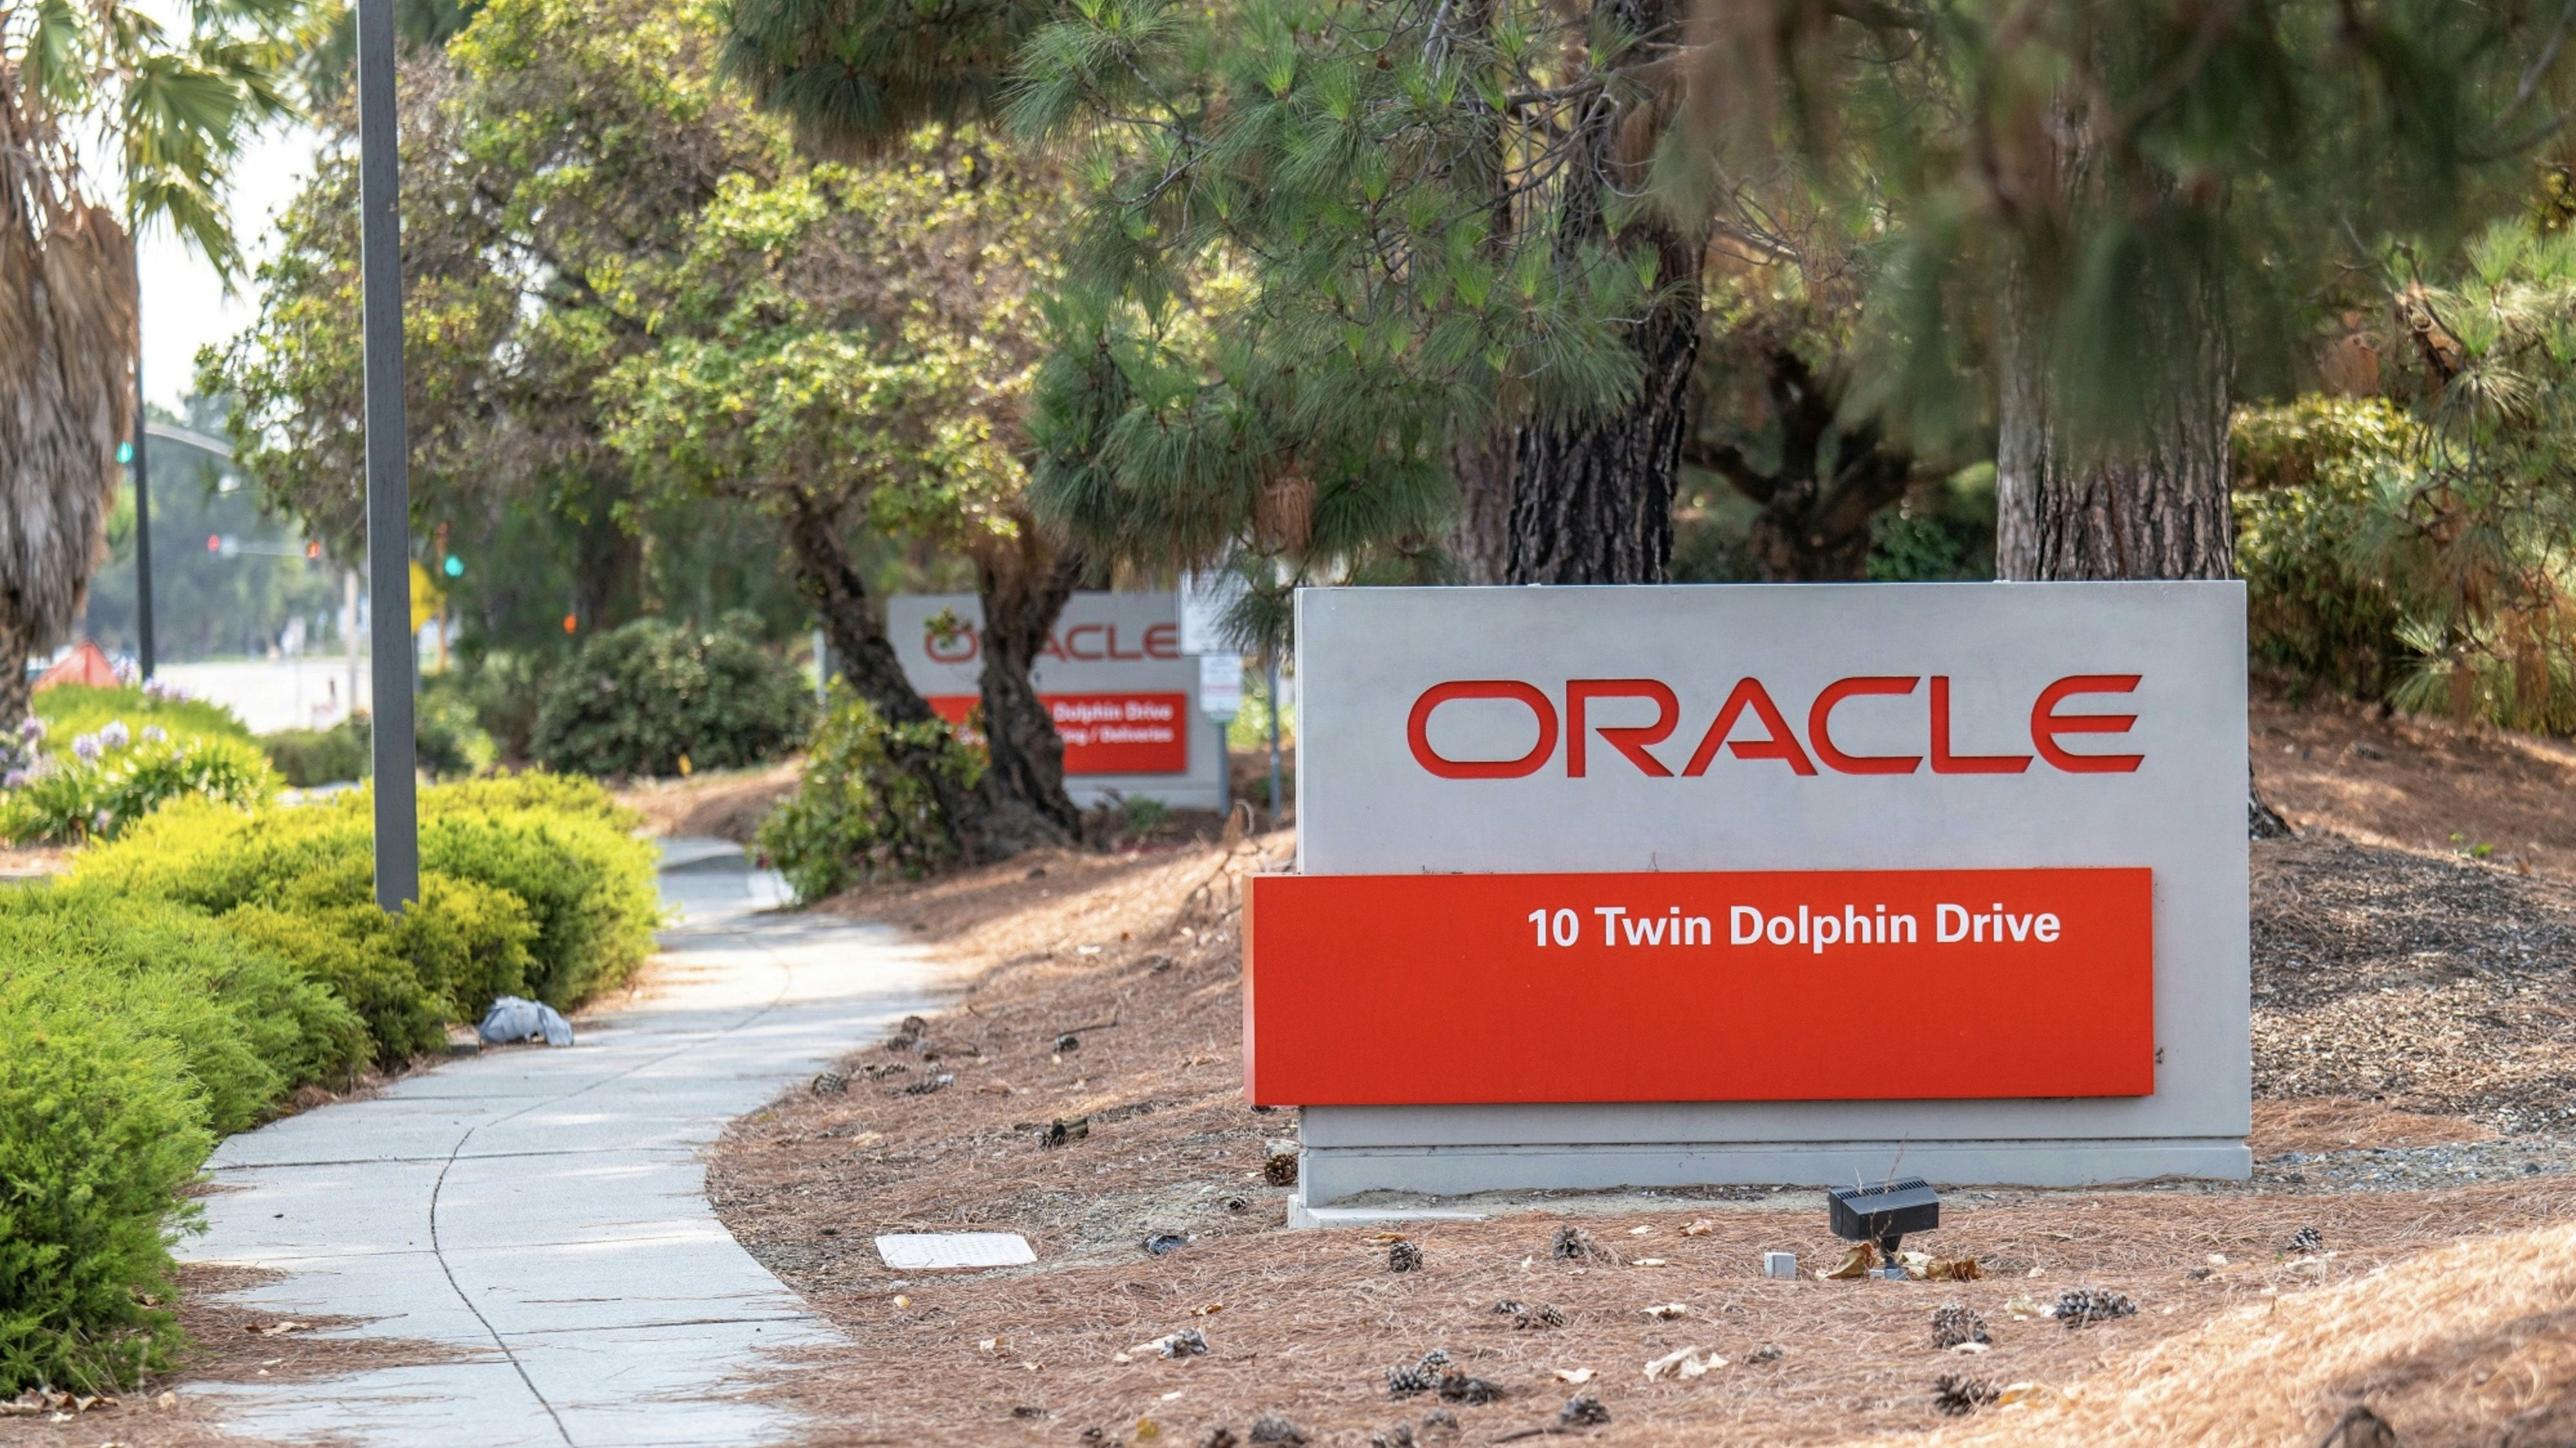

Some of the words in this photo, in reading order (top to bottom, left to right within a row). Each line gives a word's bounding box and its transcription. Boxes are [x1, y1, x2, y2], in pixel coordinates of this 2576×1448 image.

[924, 623, 1179, 663] OACLE
[1054, 701, 1123, 724] Dolphin
[1125, 700, 1173, 720] Drive
[1407, 673, 2145, 779] ORACLE
[1528, 908, 1578, 946] 10
[1594, 907, 1710, 946] Twin
[1730, 904, 1917, 954] Dolphin
[1936, 903, 2061, 943] Drive
